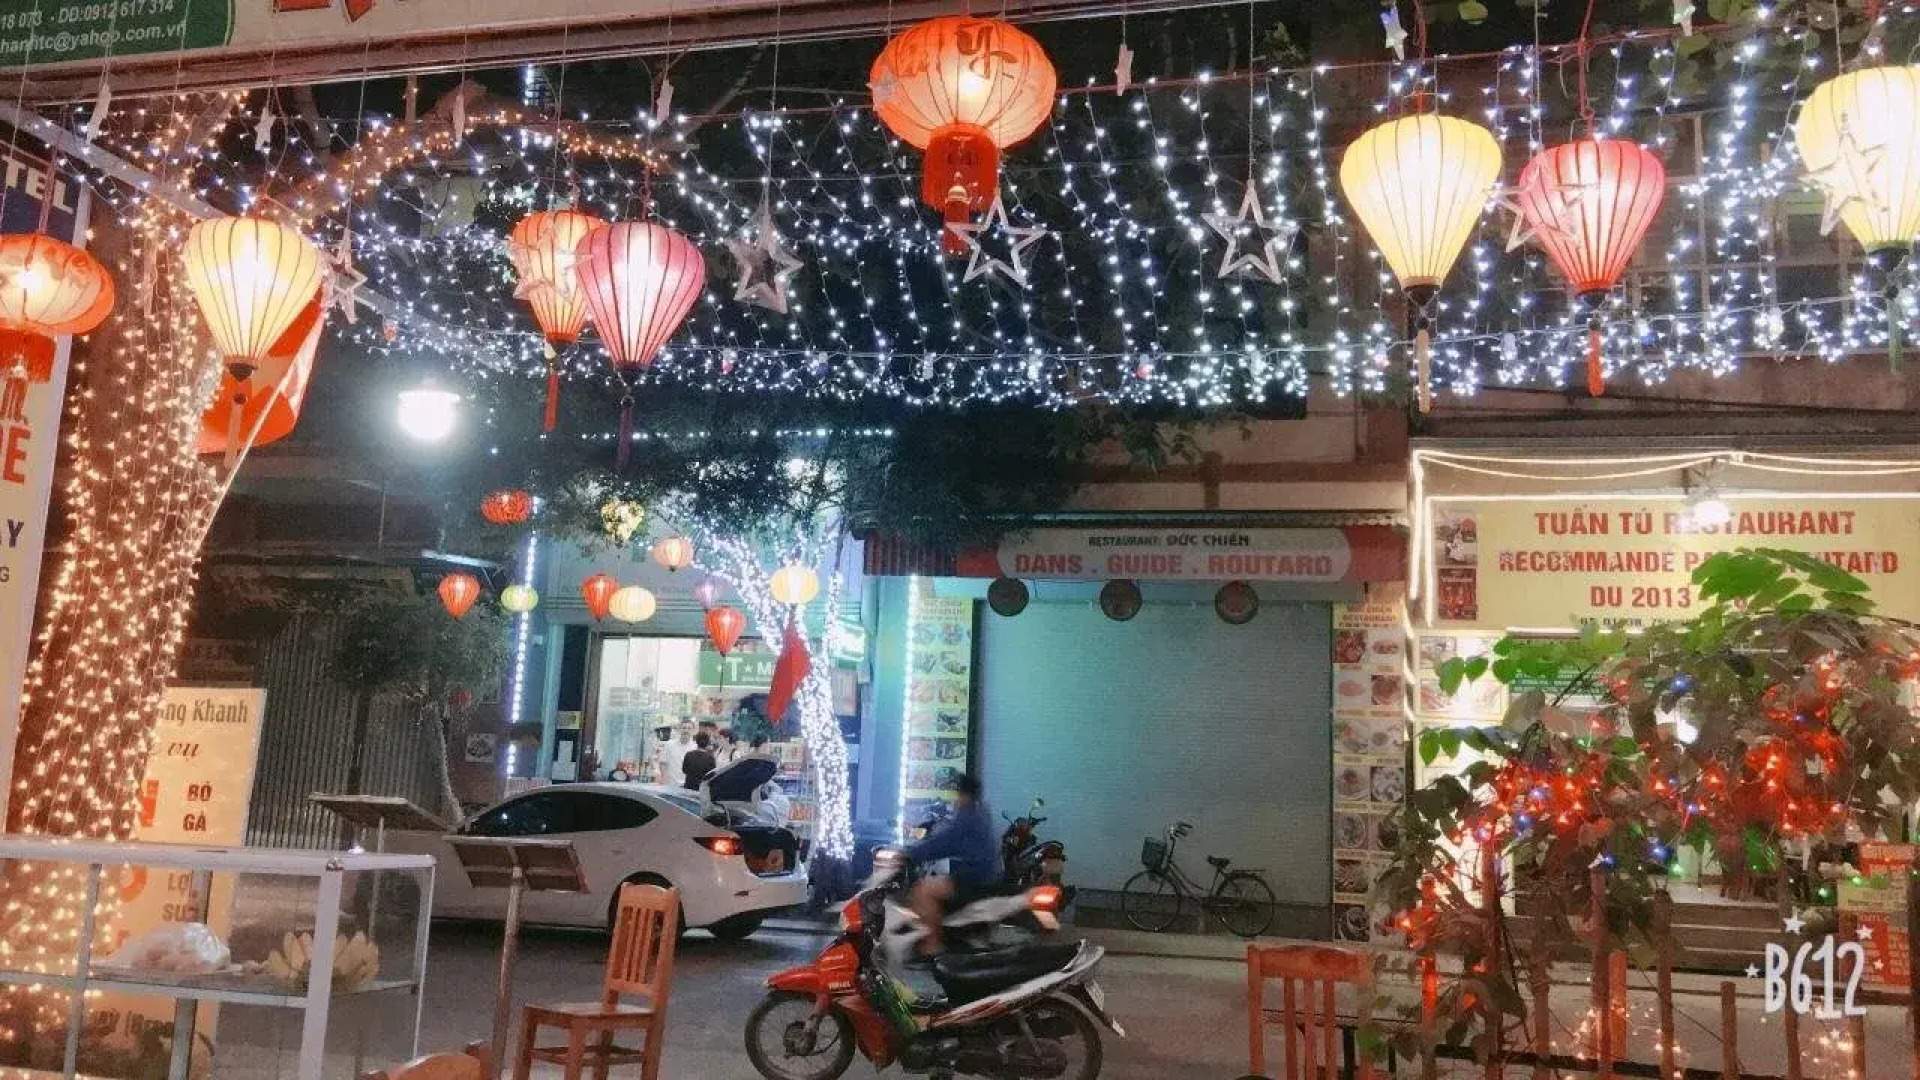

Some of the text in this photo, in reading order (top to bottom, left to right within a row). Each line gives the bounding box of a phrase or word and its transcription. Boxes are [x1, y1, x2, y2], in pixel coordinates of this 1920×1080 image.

[1015, 555, 1333, 576] DANS GUIDE ROUTARD
[1591, 586, 1691, 607] DU 2013
[192, 698, 248, 723] Khanh
